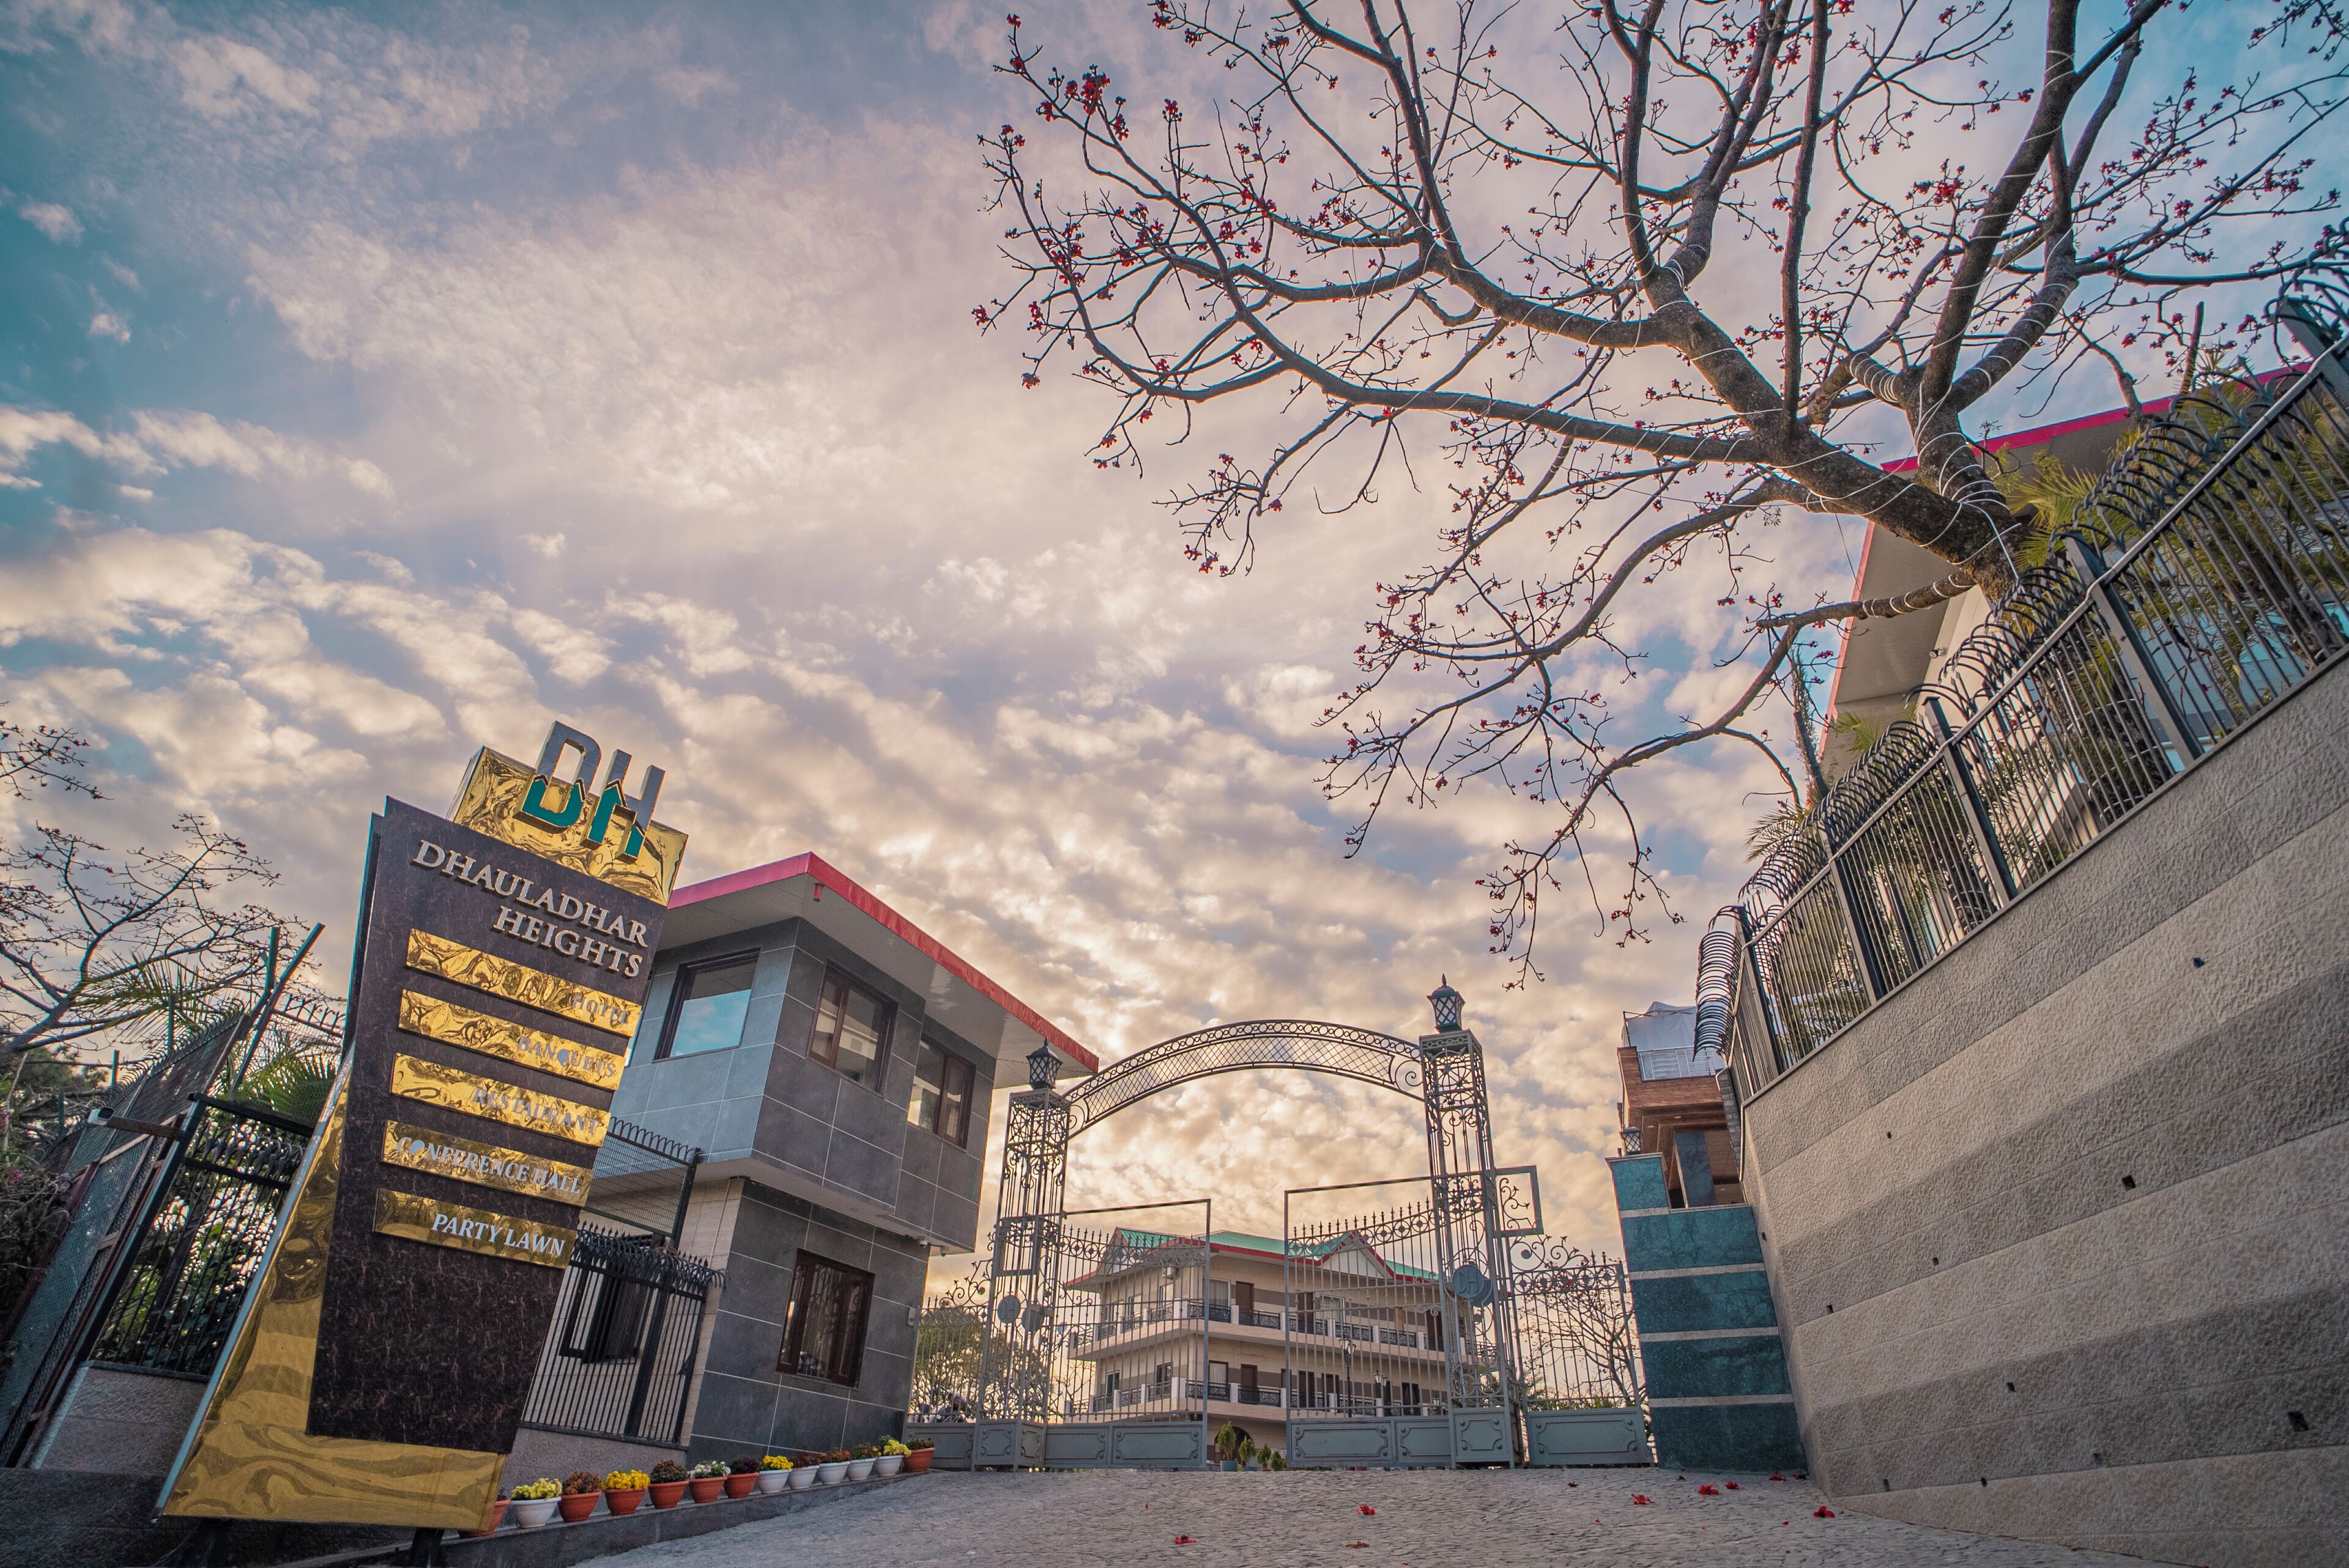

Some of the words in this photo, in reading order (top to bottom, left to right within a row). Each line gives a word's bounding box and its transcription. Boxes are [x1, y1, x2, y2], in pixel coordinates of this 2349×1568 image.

[514, 720, 666, 864] DH
[413, 840, 648, 947] DHAULADHAR
[493, 906, 642, 977] HEIGHTS
[571, 994, 629, 1024] HOTEL
[518, 1037, 615, 1077] BANQUETS
[472, 1087, 600, 1135] RESTAURANT
[398, 1137, 529, 1182] CONFERENCE
[532, 1167, 581, 1194] HALL
[431, 1213, 502, 1243] PARTY
[504, 1229, 566, 1256] LAWN
